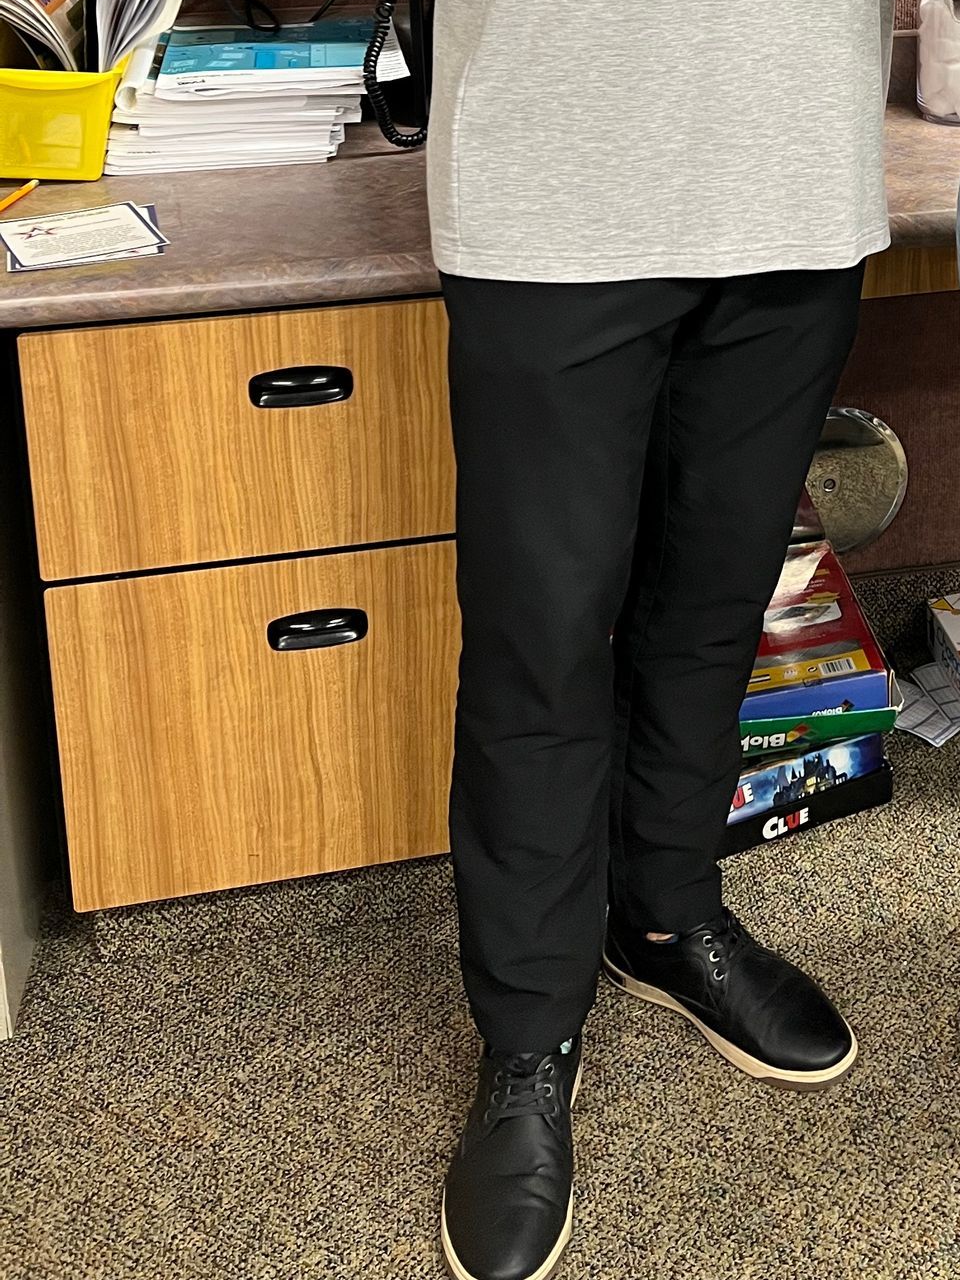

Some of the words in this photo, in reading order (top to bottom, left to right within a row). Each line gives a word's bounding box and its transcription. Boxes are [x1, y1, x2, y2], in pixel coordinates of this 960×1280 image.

[740, 732, 786, 754] Blok
[730, 782, 754, 812] UE
[762, 807, 809, 840] CLUE
